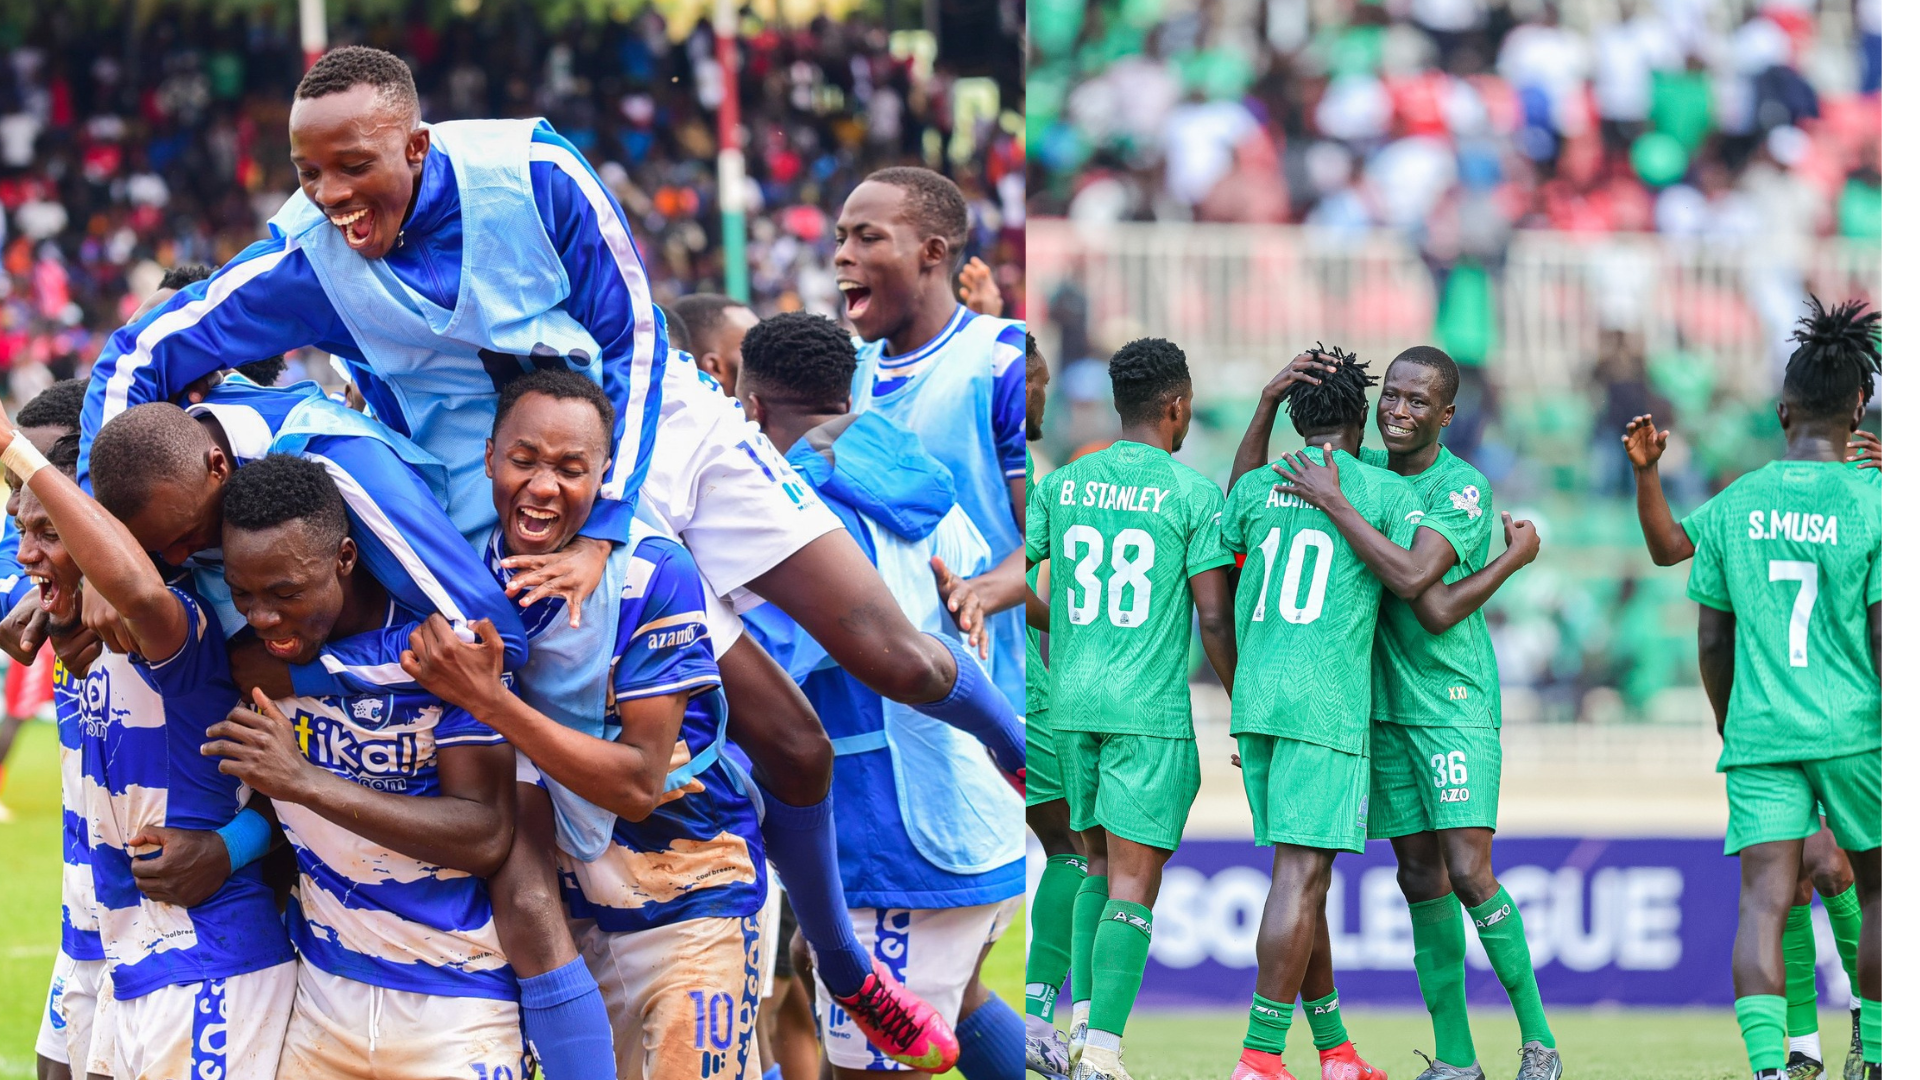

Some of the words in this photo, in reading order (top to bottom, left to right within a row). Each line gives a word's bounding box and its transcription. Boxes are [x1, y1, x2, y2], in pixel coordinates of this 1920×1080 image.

[1060, 480, 1075, 505] B.
[1082, 481, 1169, 513] STANLEY
[1748, 509, 1838, 545] S.MUSA
[1063, 524, 1155, 628] 38
[1251, 527, 1334, 625] 10
[1769, 560, 1818, 667] 7
[1448, 686, 1468, 700] XXI
[1431, 751, 1468, 787] 36
[1440, 788, 1470, 803] AZZO
[1324, 865, 1684, 972] LEGUE
[1475, 903, 1511, 928] AZZO
[687, 989, 734, 1052] 10
